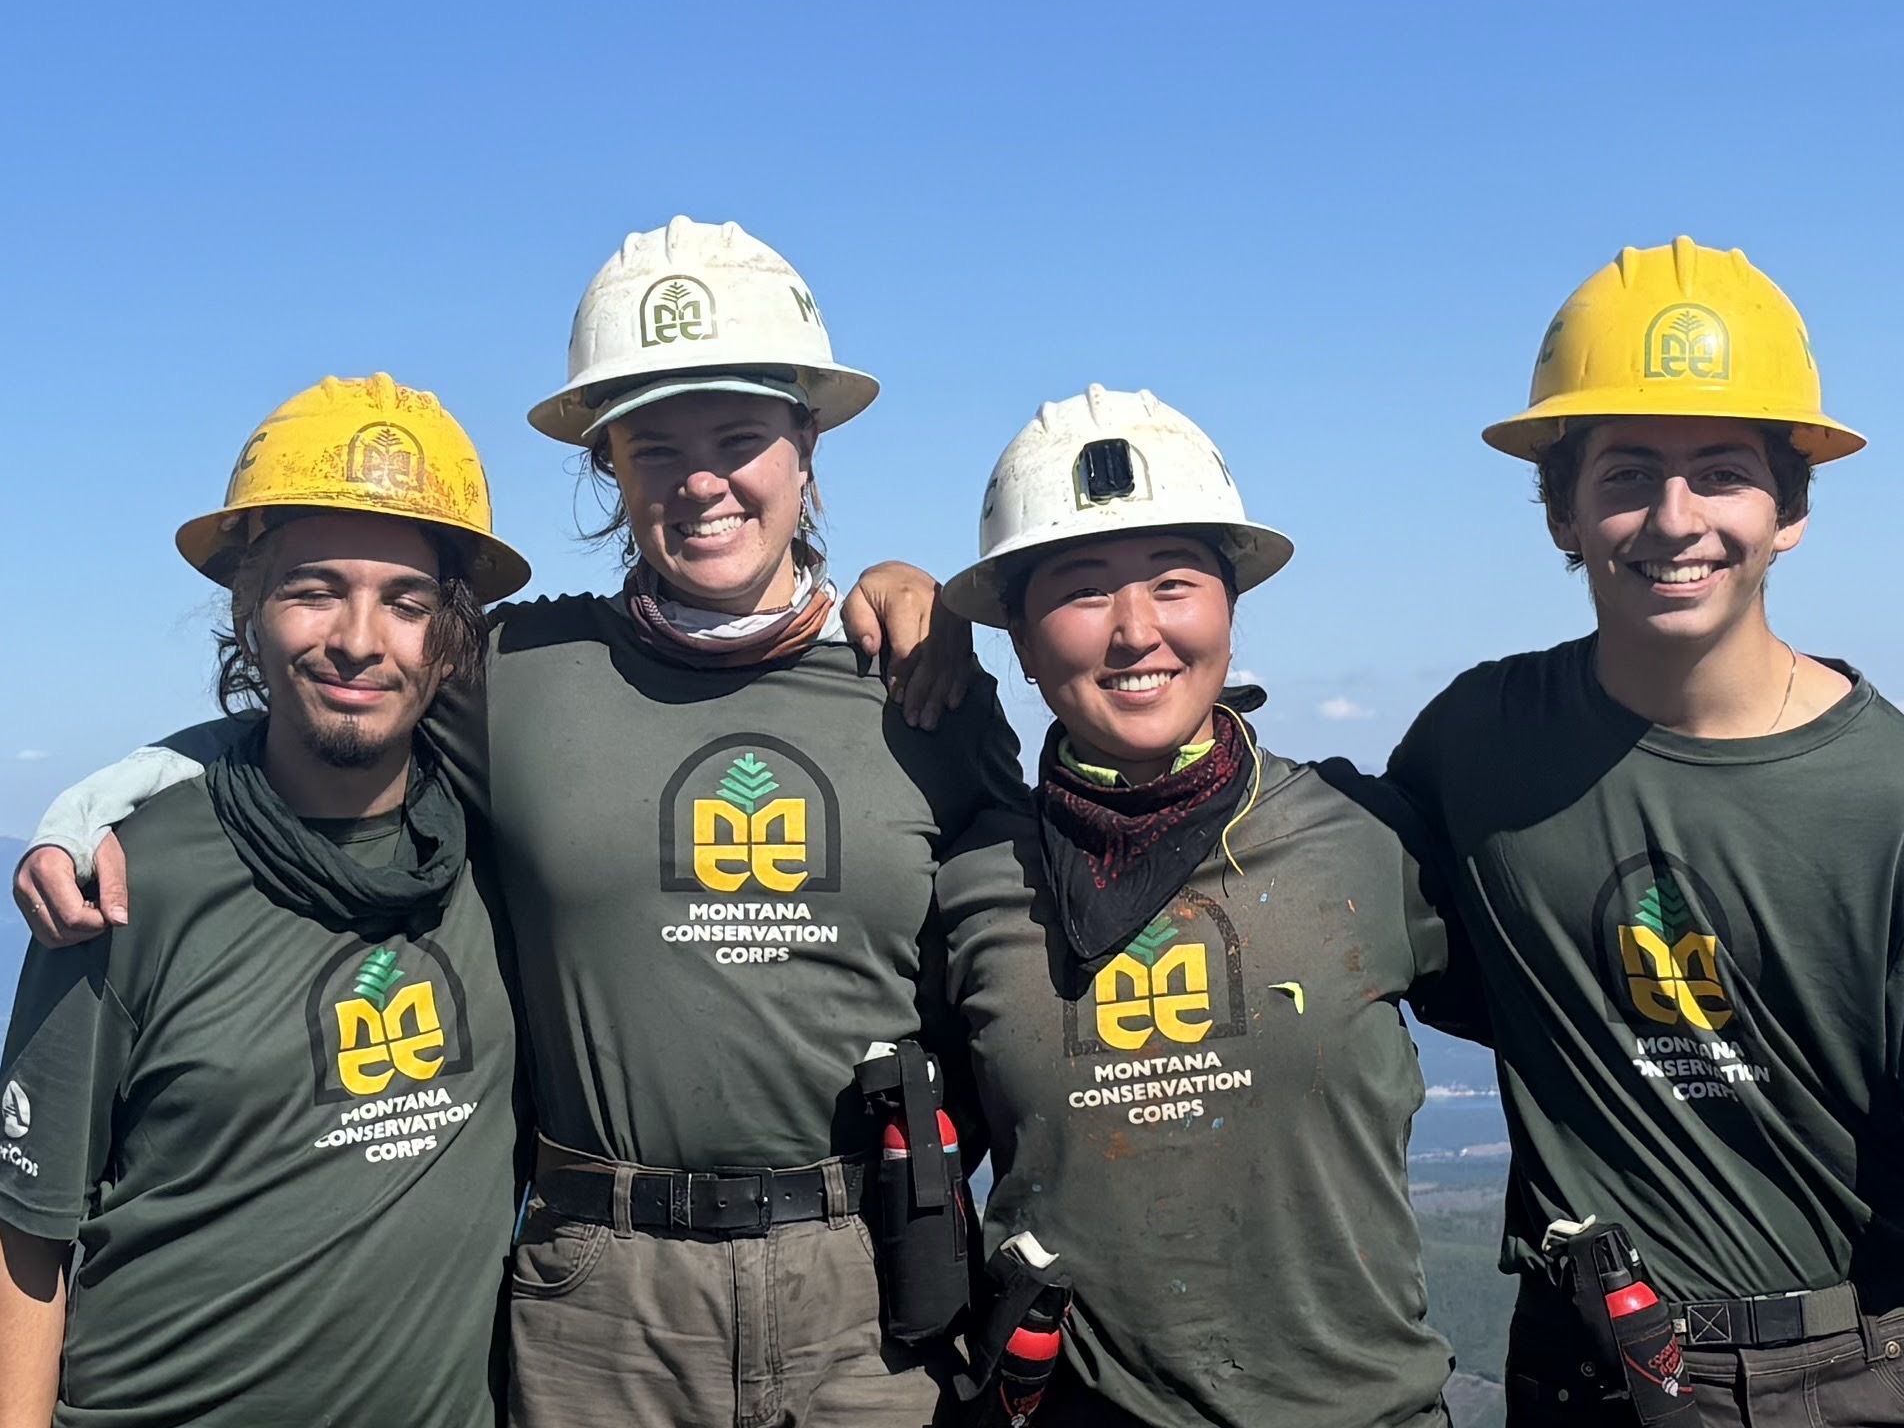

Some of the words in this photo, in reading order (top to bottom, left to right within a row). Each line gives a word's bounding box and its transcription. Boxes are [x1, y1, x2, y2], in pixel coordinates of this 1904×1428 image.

[688, 903, 812, 921] MONTANA
[661, 924, 838, 943] CONSERVATION
[715, 946, 790, 965] CORPS
[1093, 1051, 1222, 1083] MONTANA
[1068, 1069, 1252, 1109] CONSERVATION
[341, 1087, 453, 1126] MONTANA
[1128, 1099, 1205, 1125] CORPS
[314, 1102, 478, 1149] CONSERVATION
[365, 1135, 438, 1164] CORPS
